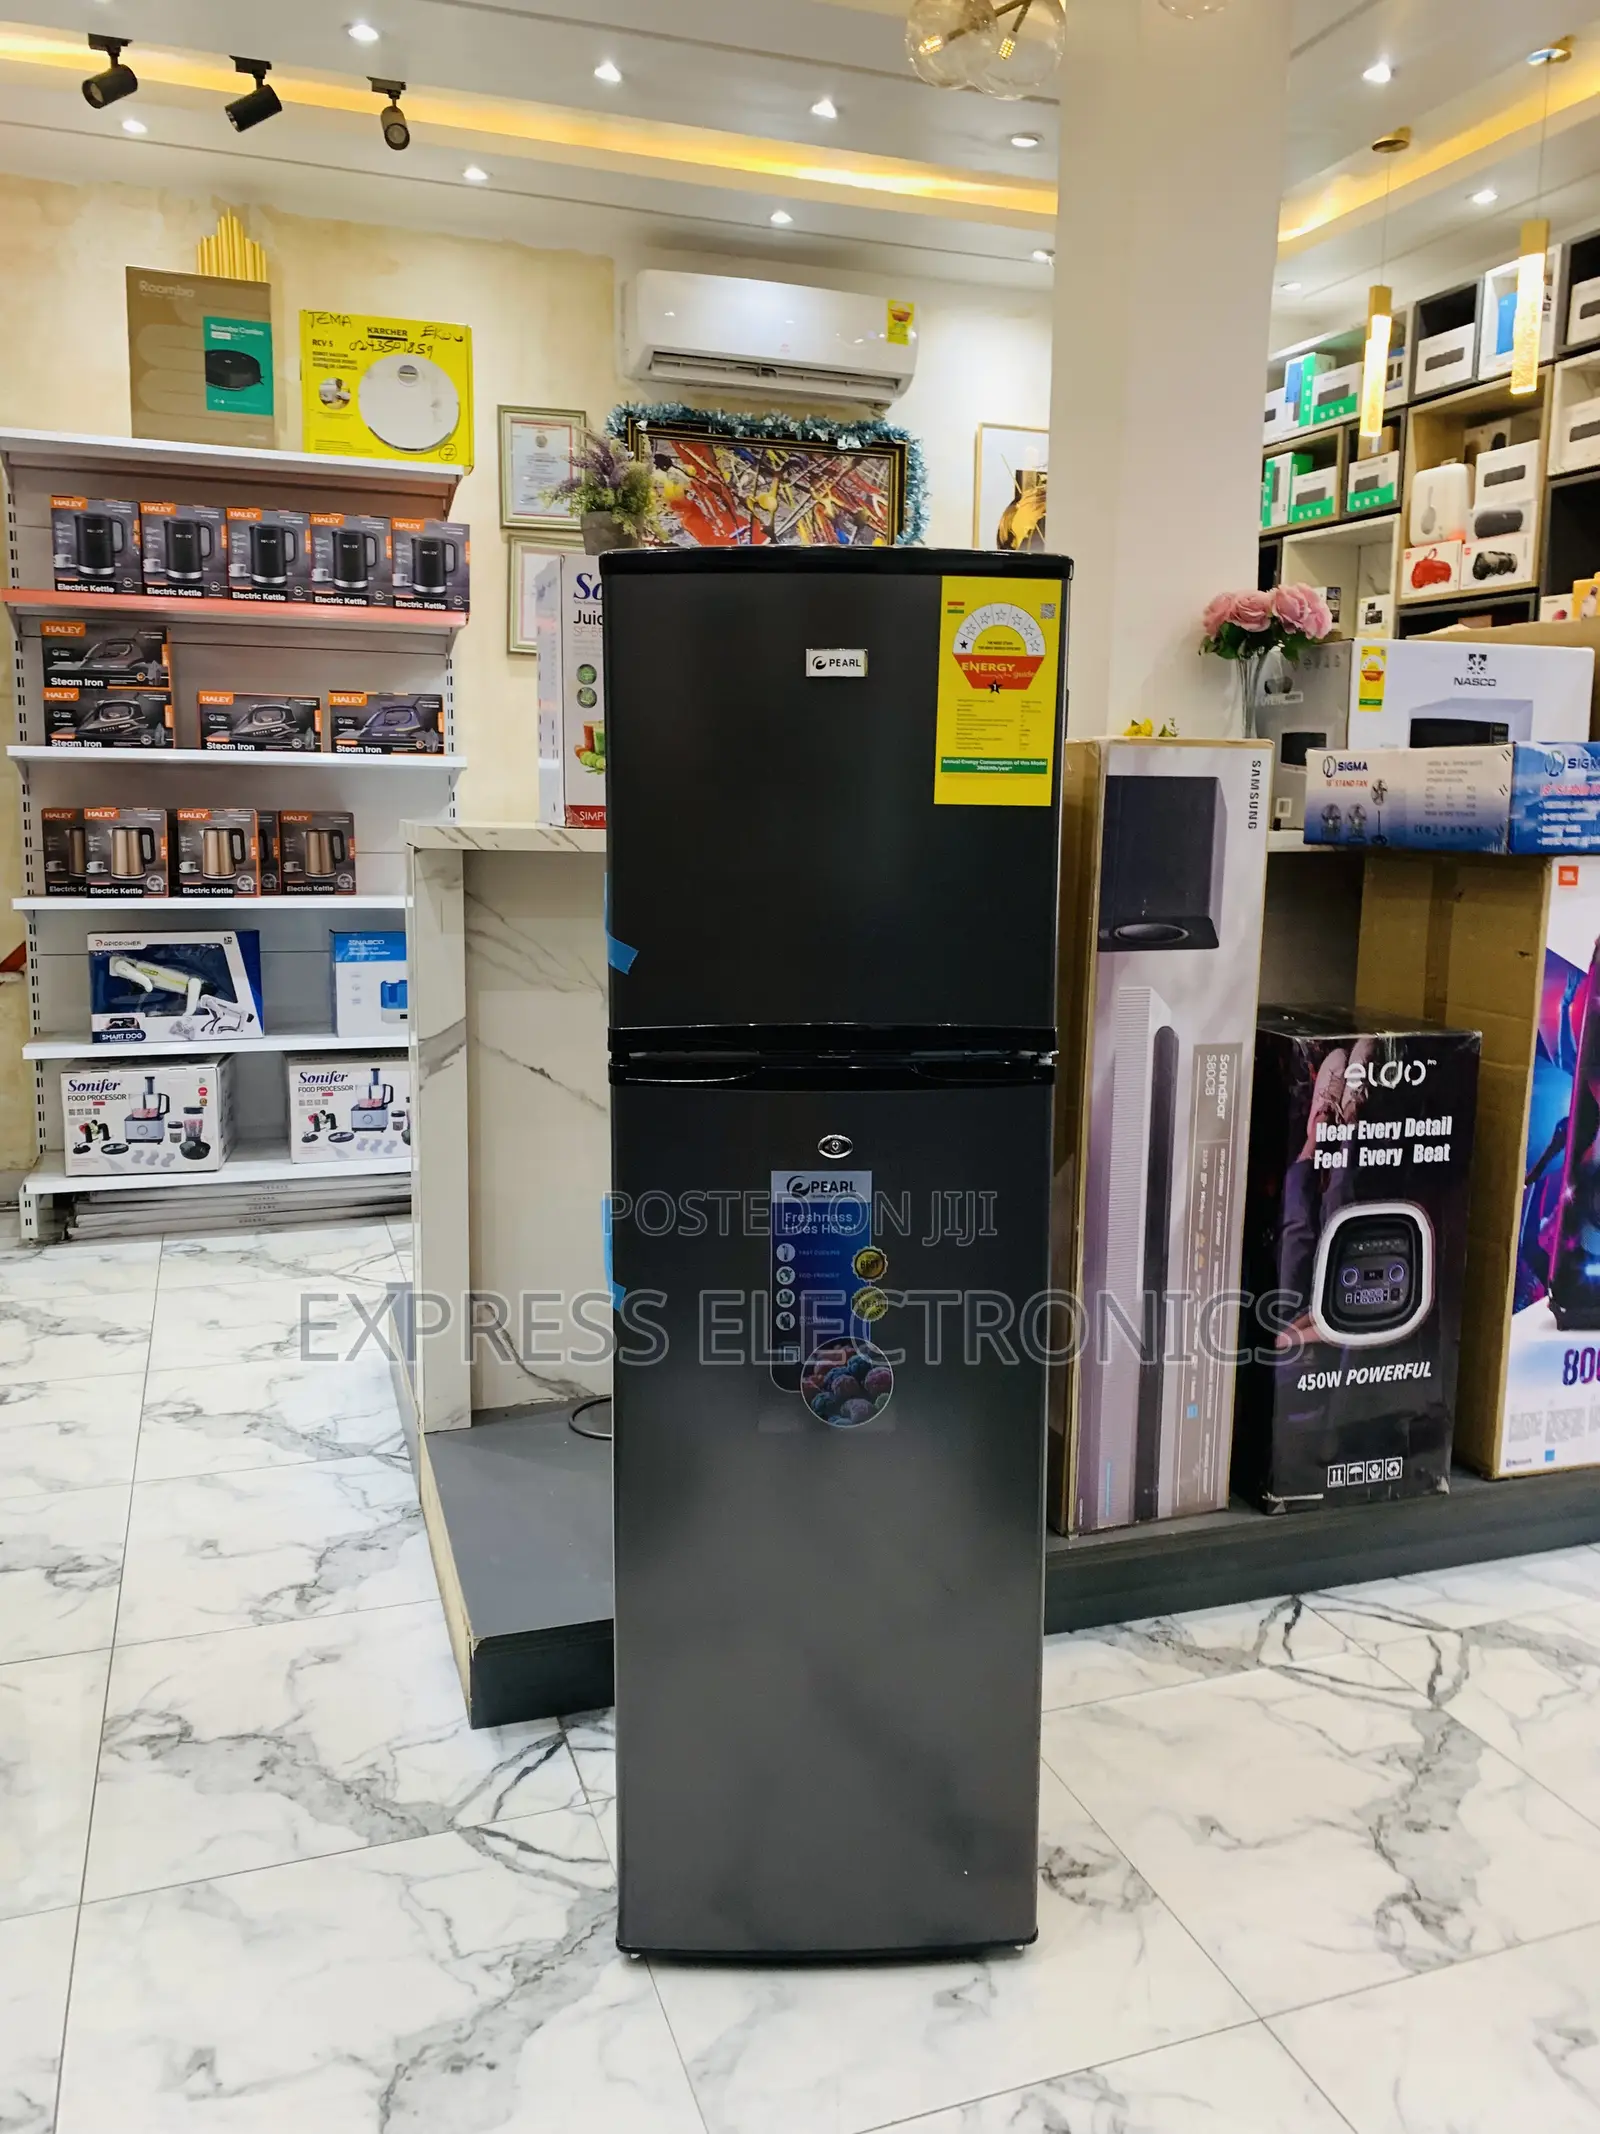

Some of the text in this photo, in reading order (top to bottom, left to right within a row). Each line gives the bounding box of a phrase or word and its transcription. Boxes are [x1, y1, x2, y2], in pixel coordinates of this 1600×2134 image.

[138, 280, 195, 298] Roomba
[307, 311, 352, 328] TEMA
[54, 499, 83, 508] HALEY
[144, 505, 173, 513] HALEY
[230, 510, 258, 519] HALEY
[313, 516, 340, 525] HALEY
[395, 521, 421, 530] HALEY
[57, 583, 115, 593] Electric Kettle
[147, 587, 202, 597] Electric Kettle
[232, 591, 286, 602] Electric Kettle
[315, 596, 367, 606] Electric Kettle
[395, 600, 447, 610] Electric Kettle
[46, 625, 82, 634] HALEY
[829, 658, 862, 667] PEARL
[961, 661, 1016, 673] ENERGY
[51, 677, 103, 687] Steam Iron
[1454, 677, 1497, 687] NASCO
[46, 691, 76, 699] HALEY
[202, 695, 231, 704] HALEY
[332, 695, 363, 704] HALEY
[51, 739, 82, 747] Steam
[206, 741, 255, 751] Steam Iron
[336, 745, 382, 754] Steam Iron
[1338, 761, 1368, 771] SIGMA
[1247, 759, 1262, 830] SAMSUNG
[101, 1033, 125, 1041] SMART
[299, 1070, 349, 1085] Sonifer
[67, 1078, 121, 1094] Sonifer
[1216, 1053, 1230, 1120] Soundbar
[87, 1093, 127, 1101] PROCESSOR
[1315, 1116, 1453, 1143] Hear Every Detail
[1314, 1143, 1451, 1170] Feel Every Beat
[811, 1180, 857, 1193] PEARL
[785, 1211, 853, 1223] Freshness
[785, 1223, 818, 1234] Lives
[1297, 1361, 1432, 1392] 450W POWERFUL
